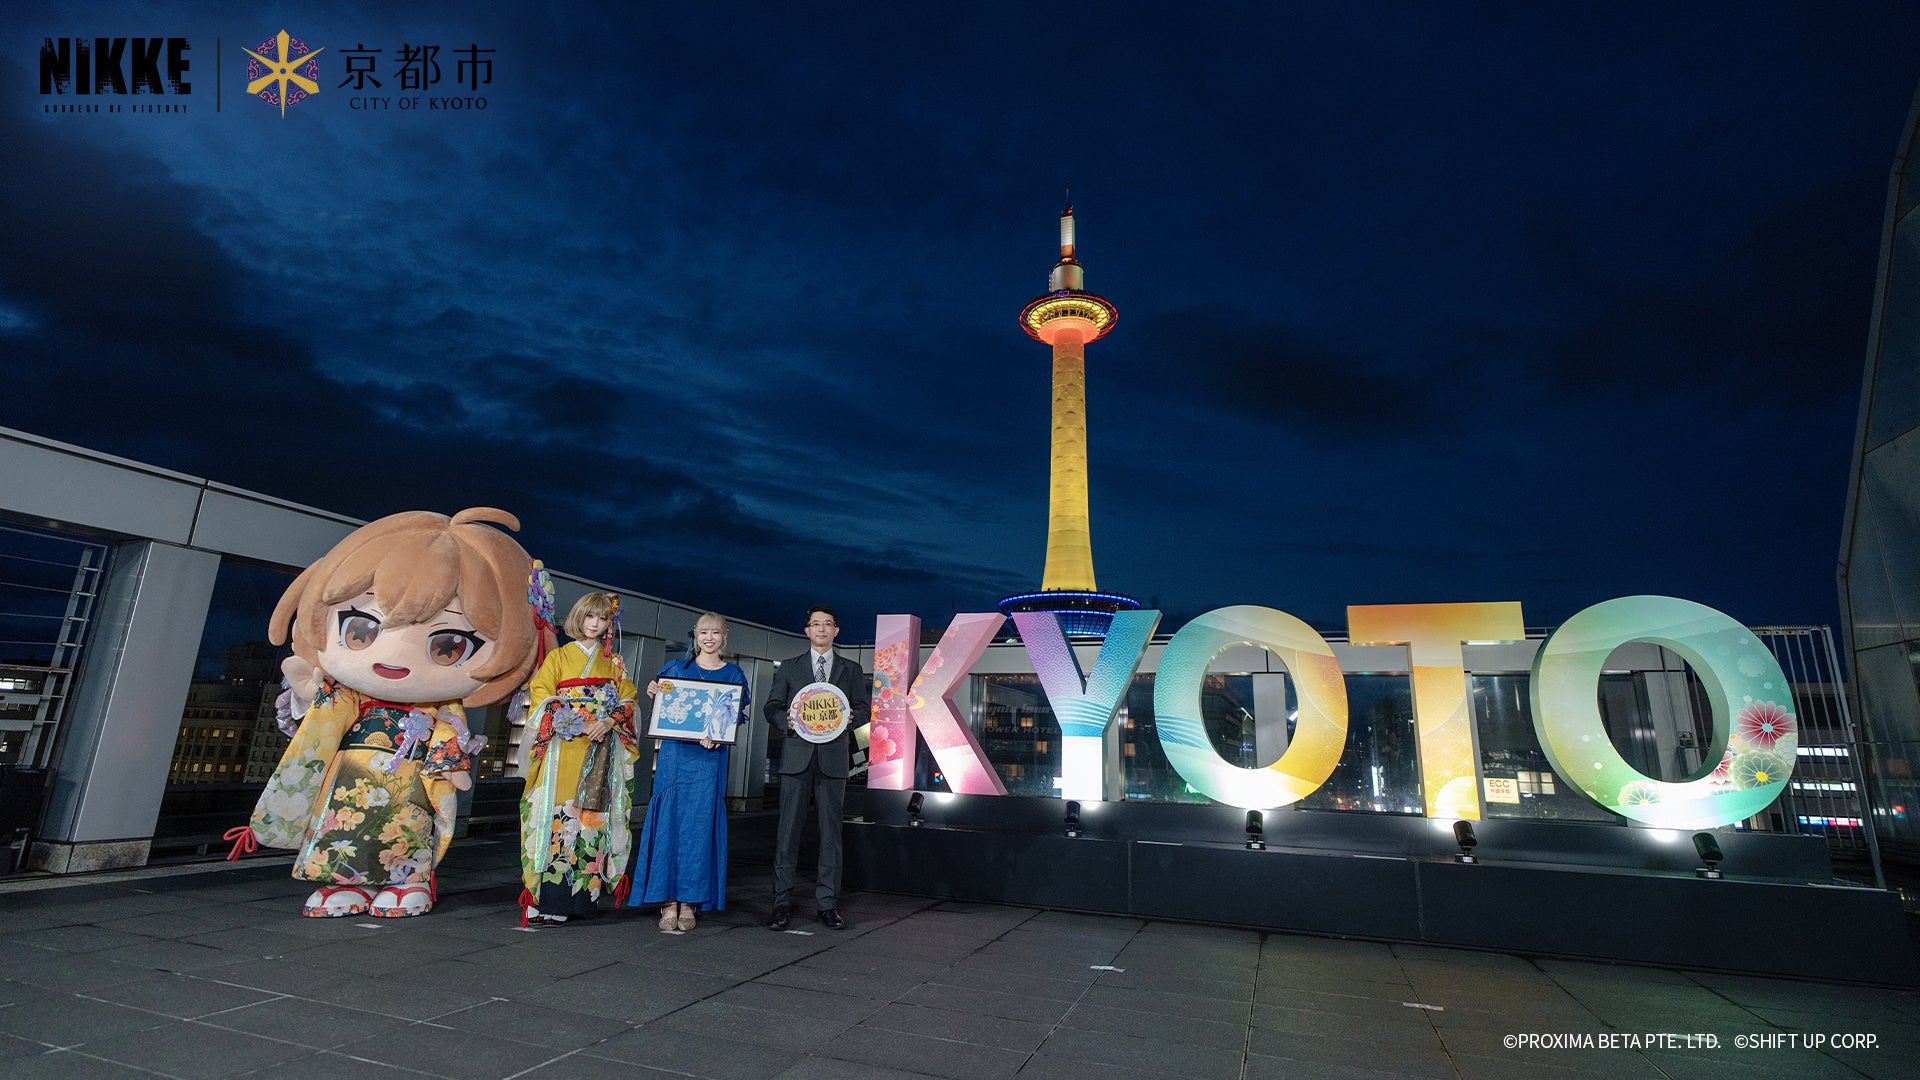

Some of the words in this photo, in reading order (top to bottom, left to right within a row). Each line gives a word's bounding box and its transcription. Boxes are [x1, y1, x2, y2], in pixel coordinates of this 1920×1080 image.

[803, 698, 839, 711] NIKKE
[866, 594, 1798, 830] KYOTO
[1489, 779, 1510, 788] ECC
